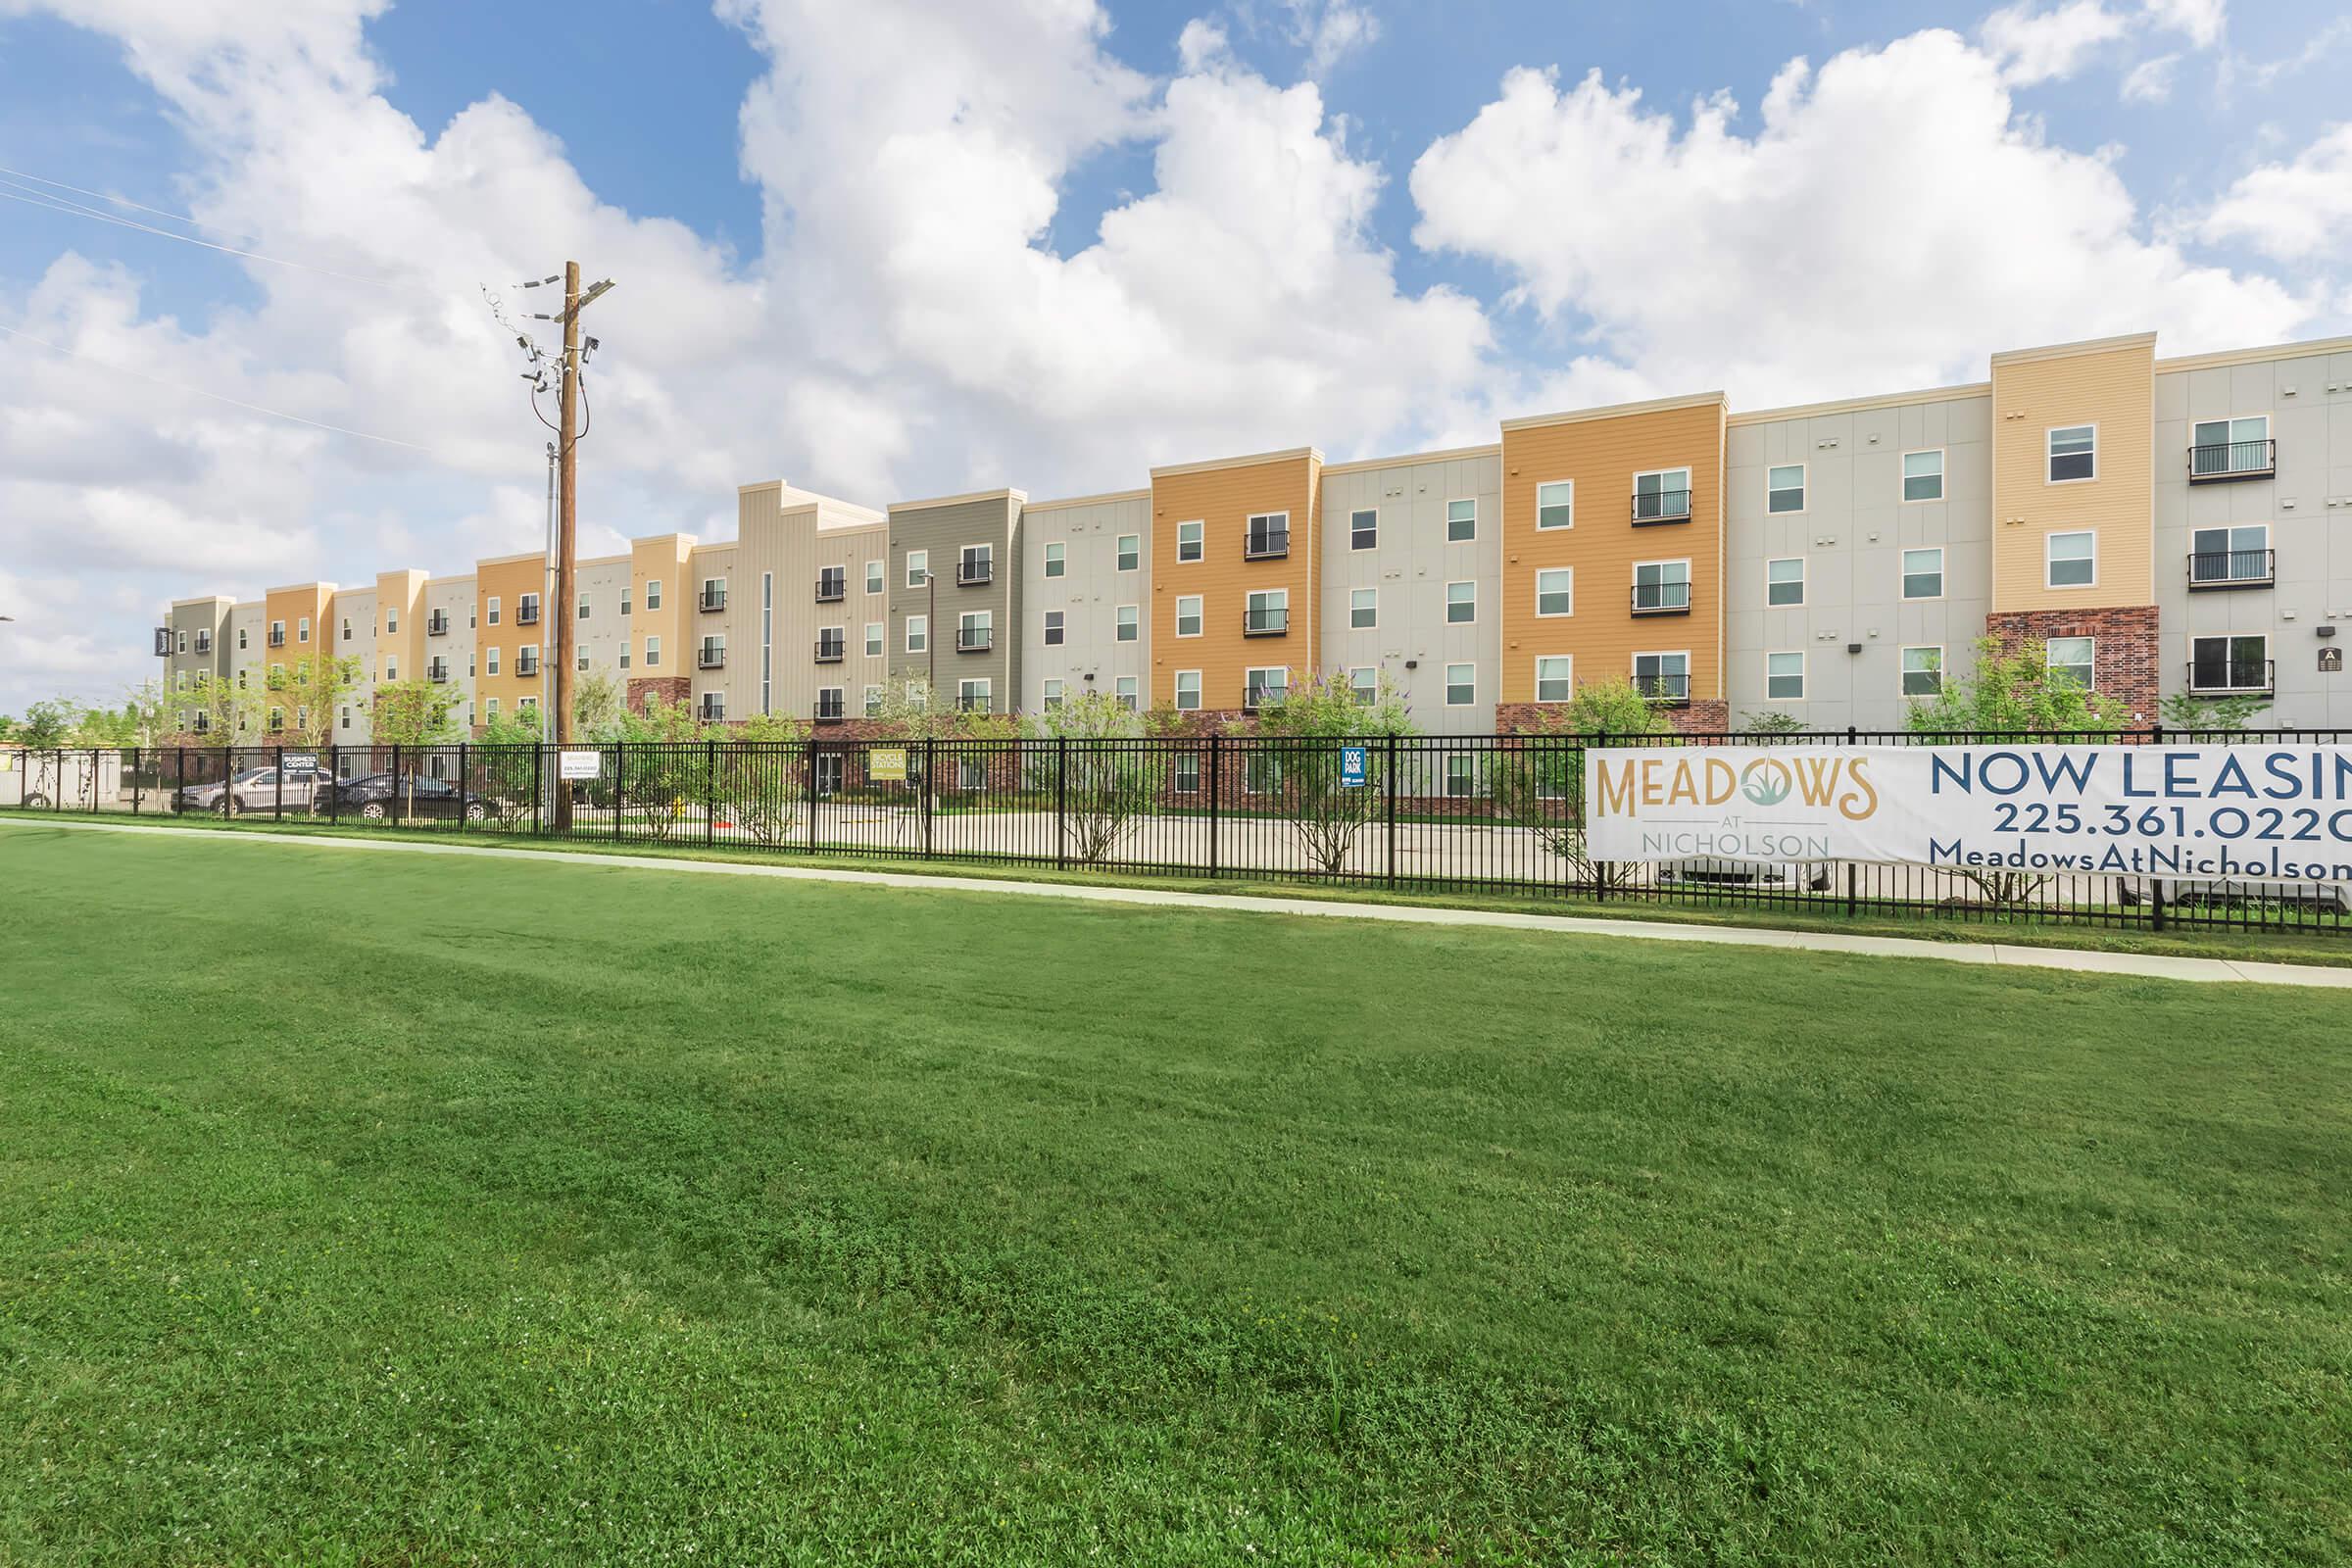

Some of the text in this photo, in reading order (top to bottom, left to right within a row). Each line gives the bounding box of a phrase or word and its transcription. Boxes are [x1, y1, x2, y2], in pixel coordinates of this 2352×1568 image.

[2325, 651, 2335, 660] A
[872, 753, 903, 761] BICYCLE
[1345, 751, 1361, 762] DOG
[1345, 762, 1361, 774] PARK
[1932, 752, 2099, 796] NOW
[1596, 756, 1879, 821] MEADOWS
[1721, 815, 1741, 829] AT
[1993, 803, 2352, 843] 225.361.0220
[1642, 832, 1829, 858] NICHOLSON
